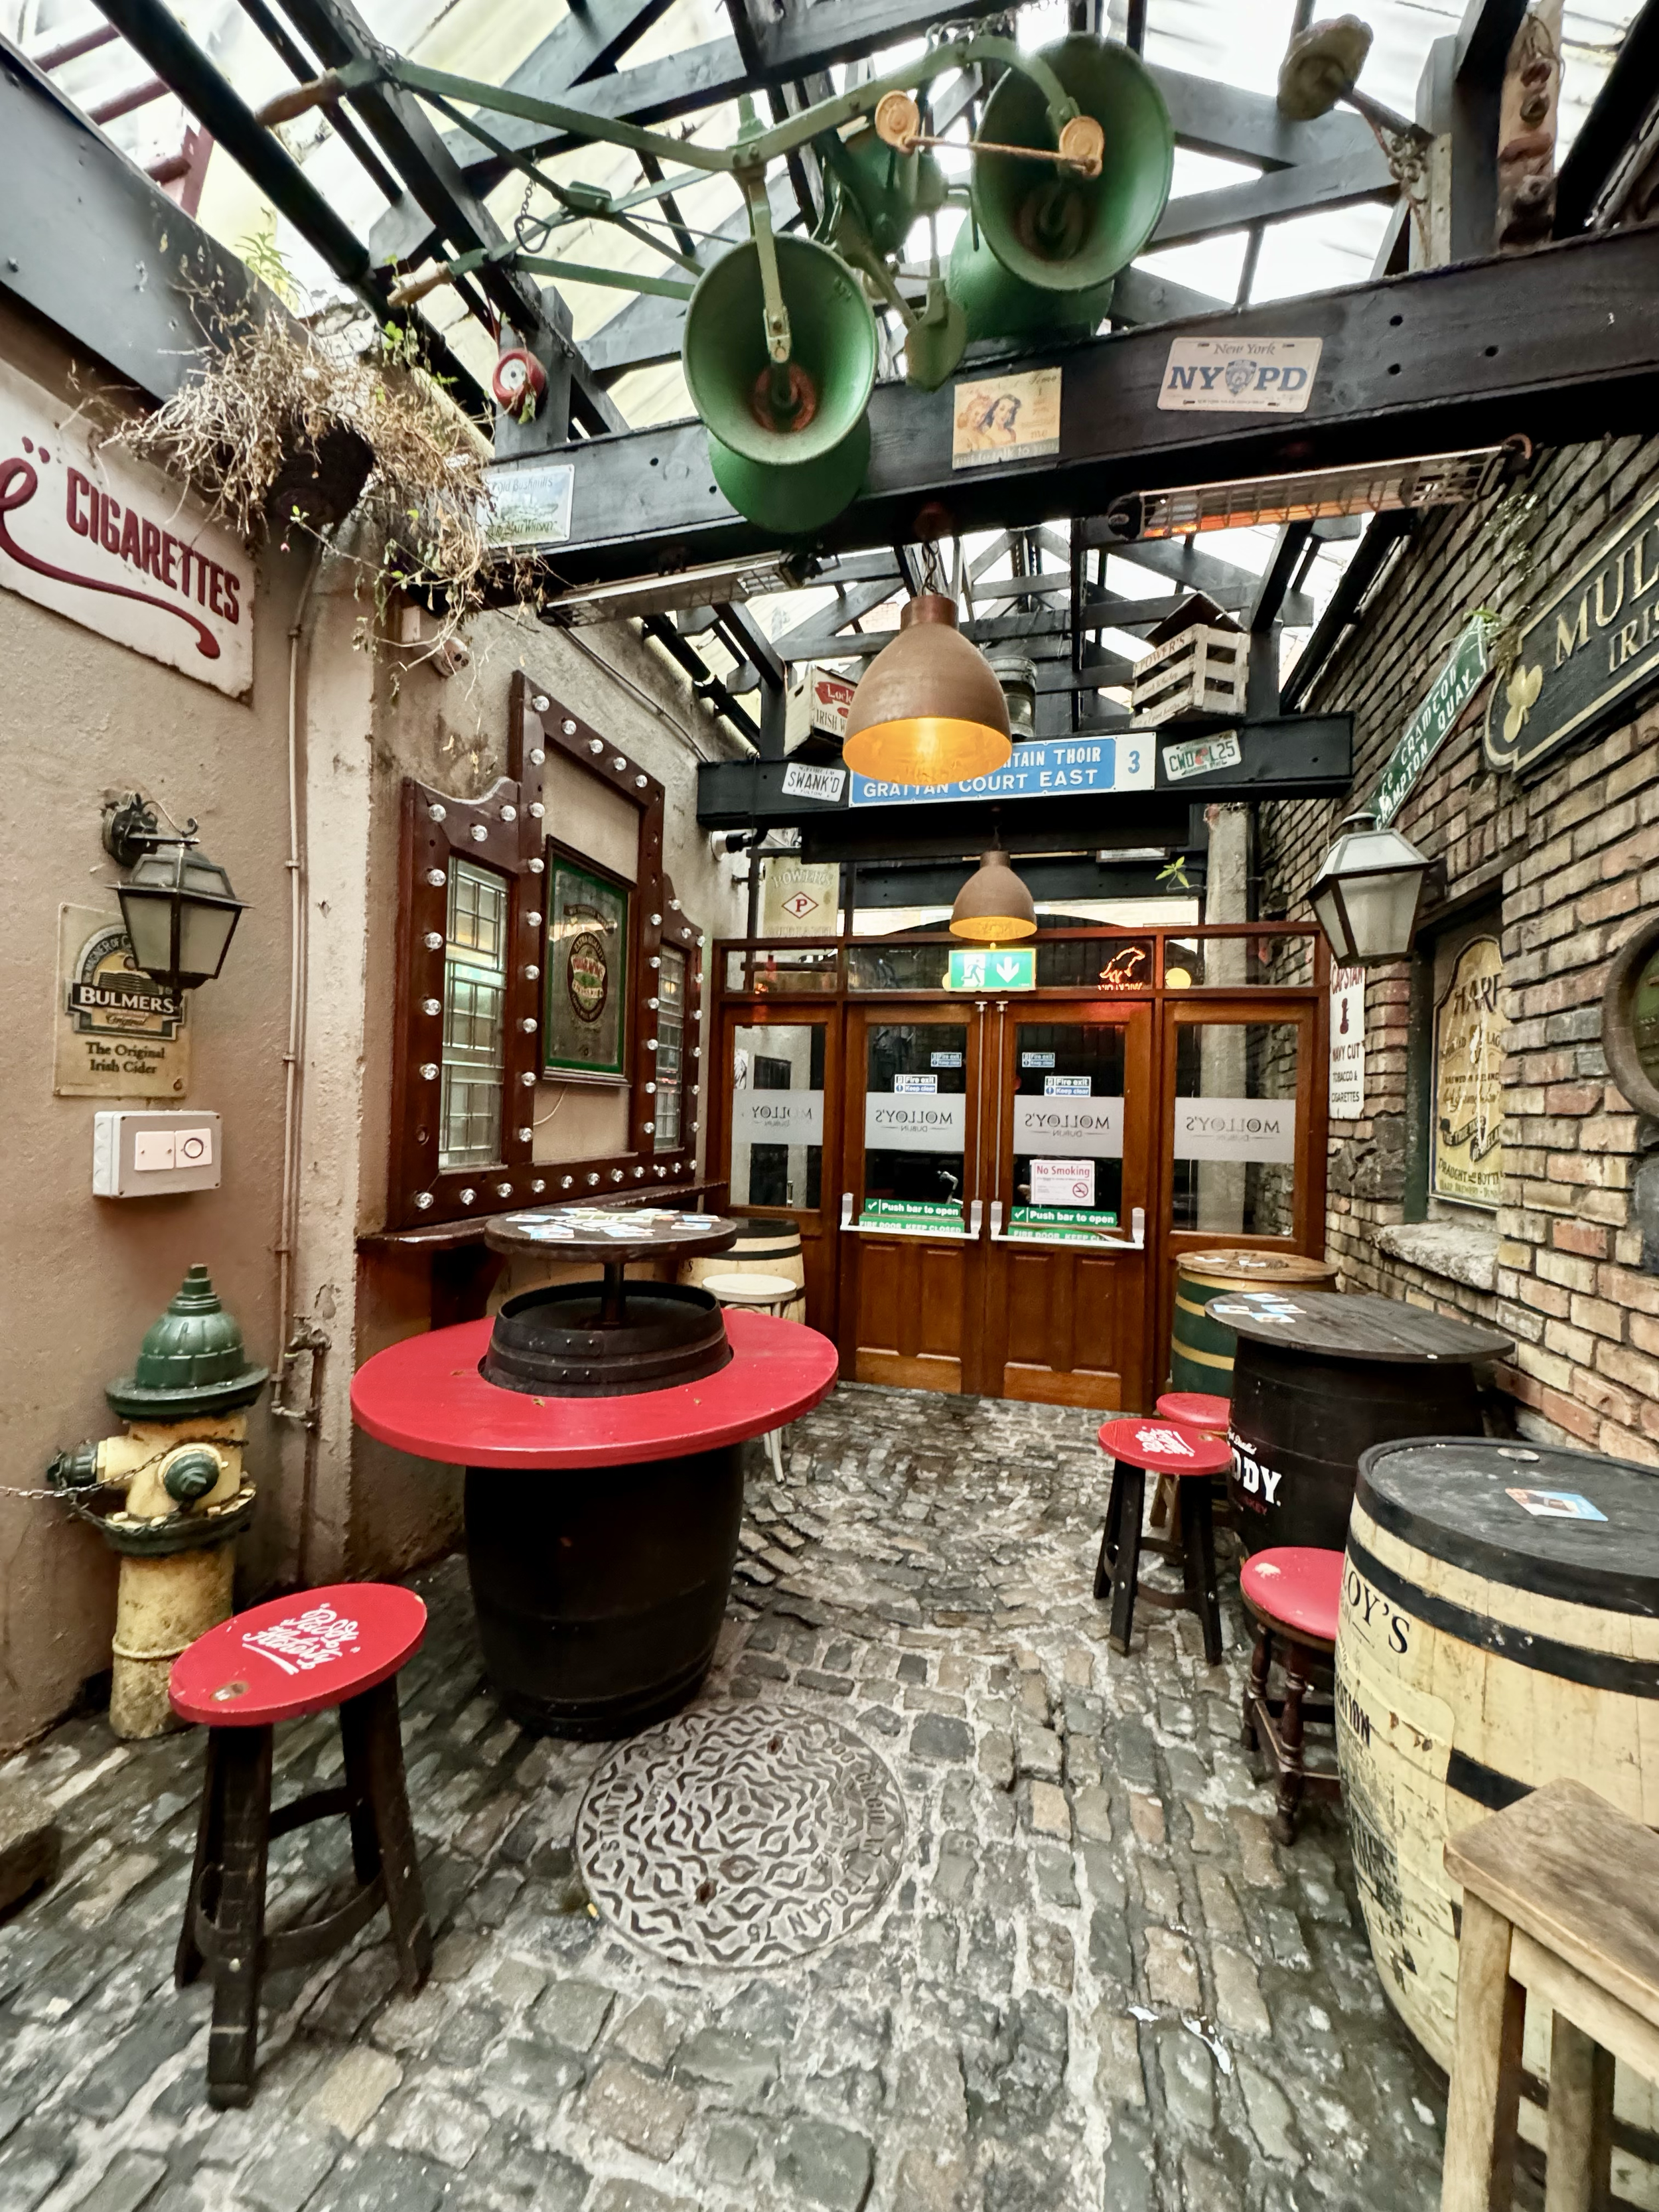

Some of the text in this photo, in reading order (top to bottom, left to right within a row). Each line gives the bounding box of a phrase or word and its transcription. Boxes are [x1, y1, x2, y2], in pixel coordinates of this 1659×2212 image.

[1213, 342, 1275, 354] New York
[66, 466, 240, 625] CIGARETTES
[816, 709, 837, 731] IRISH
[1053, 747, 1101, 765] THOIR
[1128, 751, 1140, 773] 3
[788, 771, 840, 793] SWANK'D
[959, 774, 1028, 793] COURT
[1040, 769, 1098, 788] EAST
[796, 899, 808, 913] P
[1331, 966, 1363, 995] CAPSTAN
[80, 986, 175, 1014] BULMERS
[86, 1042, 165, 1061] The Original
[1333, 1043, 1360, 1062] NAVY CUT
[90, 1059, 157, 1074] Irish Cider
[1332, 1070, 1353, 1083] TOBACCO
[1331, 1092, 1360, 1103] CIGARETTES
[1037, 1165, 1090, 1177] No Smoking
[882, 1202, 959, 1217] Push bar to open
[1030, 1210, 1114, 1225] Push bar to open
